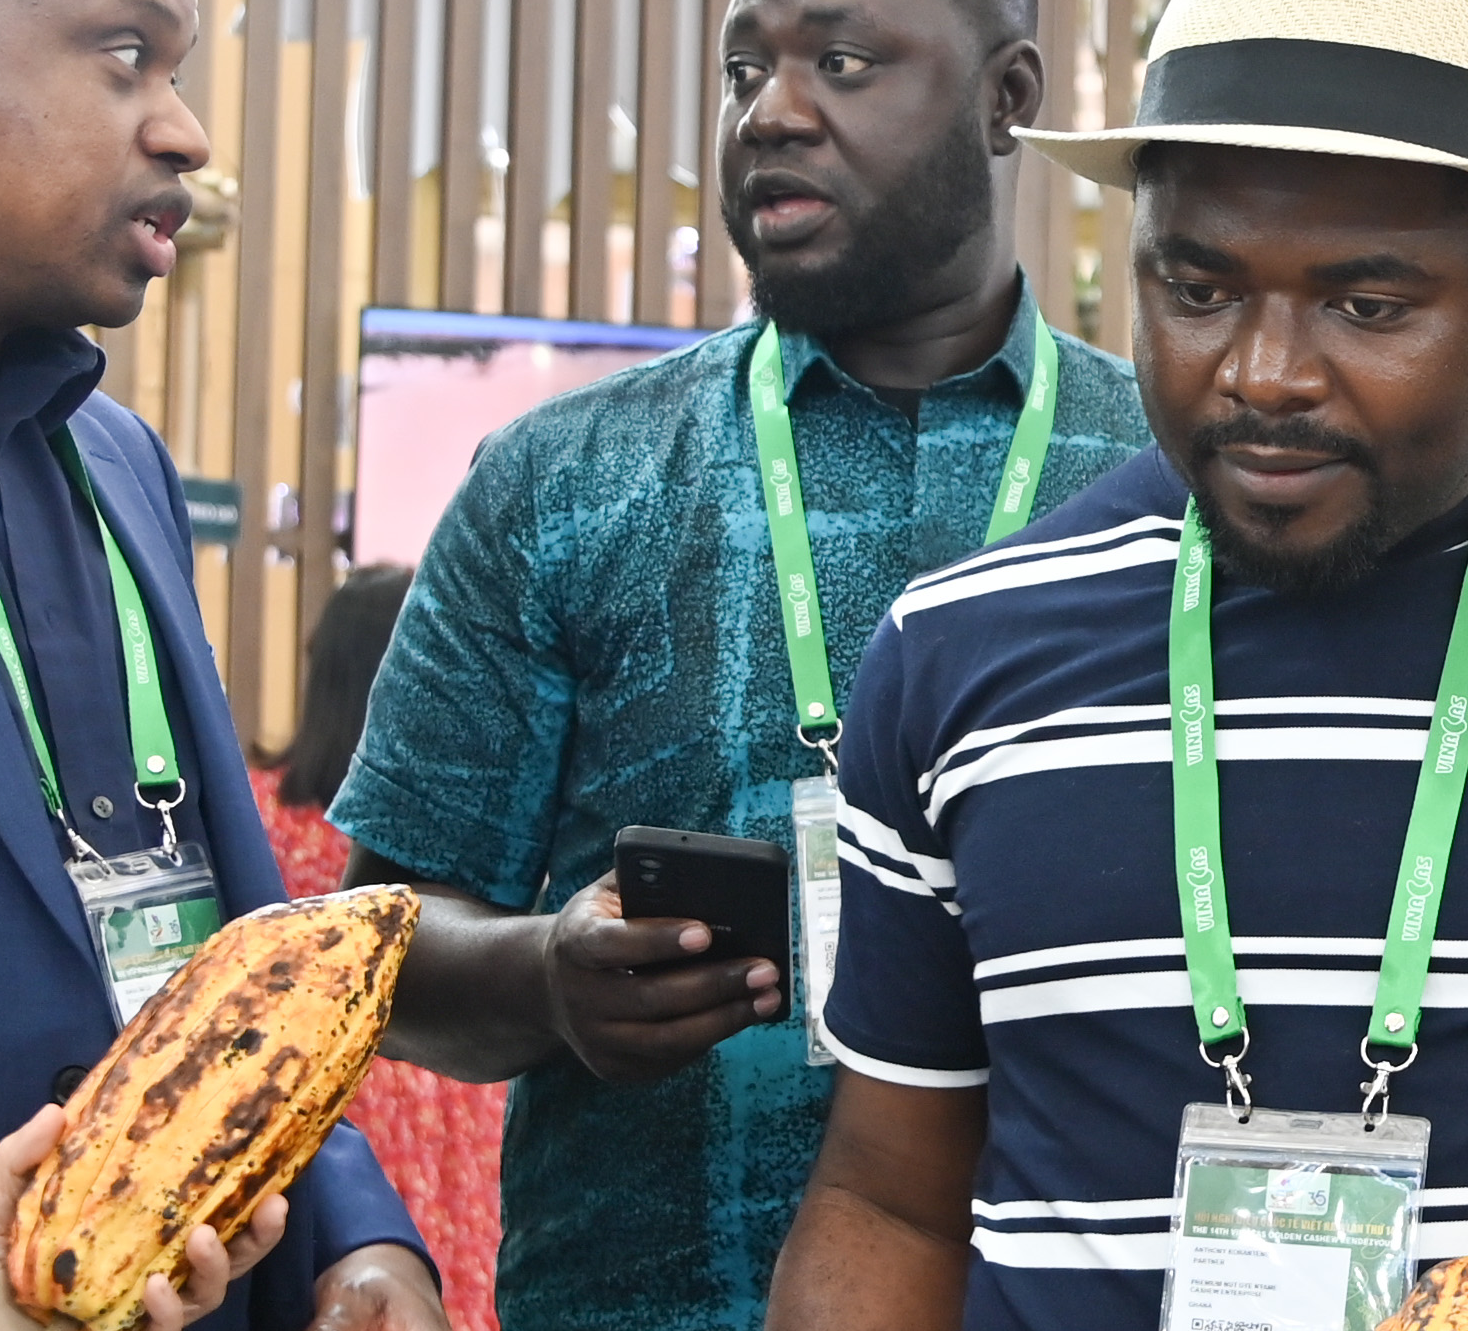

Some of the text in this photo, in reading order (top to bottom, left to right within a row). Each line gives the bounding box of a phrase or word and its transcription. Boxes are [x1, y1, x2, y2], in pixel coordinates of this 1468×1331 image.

[1179, 683, 1206, 768] VINACAS
[1434, 693, 1468, 775] VINACAS
[1185, 844, 1215, 934] VINACAS
[1400, 855, 1434, 943] VINACAS
[1338, 1236, 1396, 1248] RENDEZVOU
